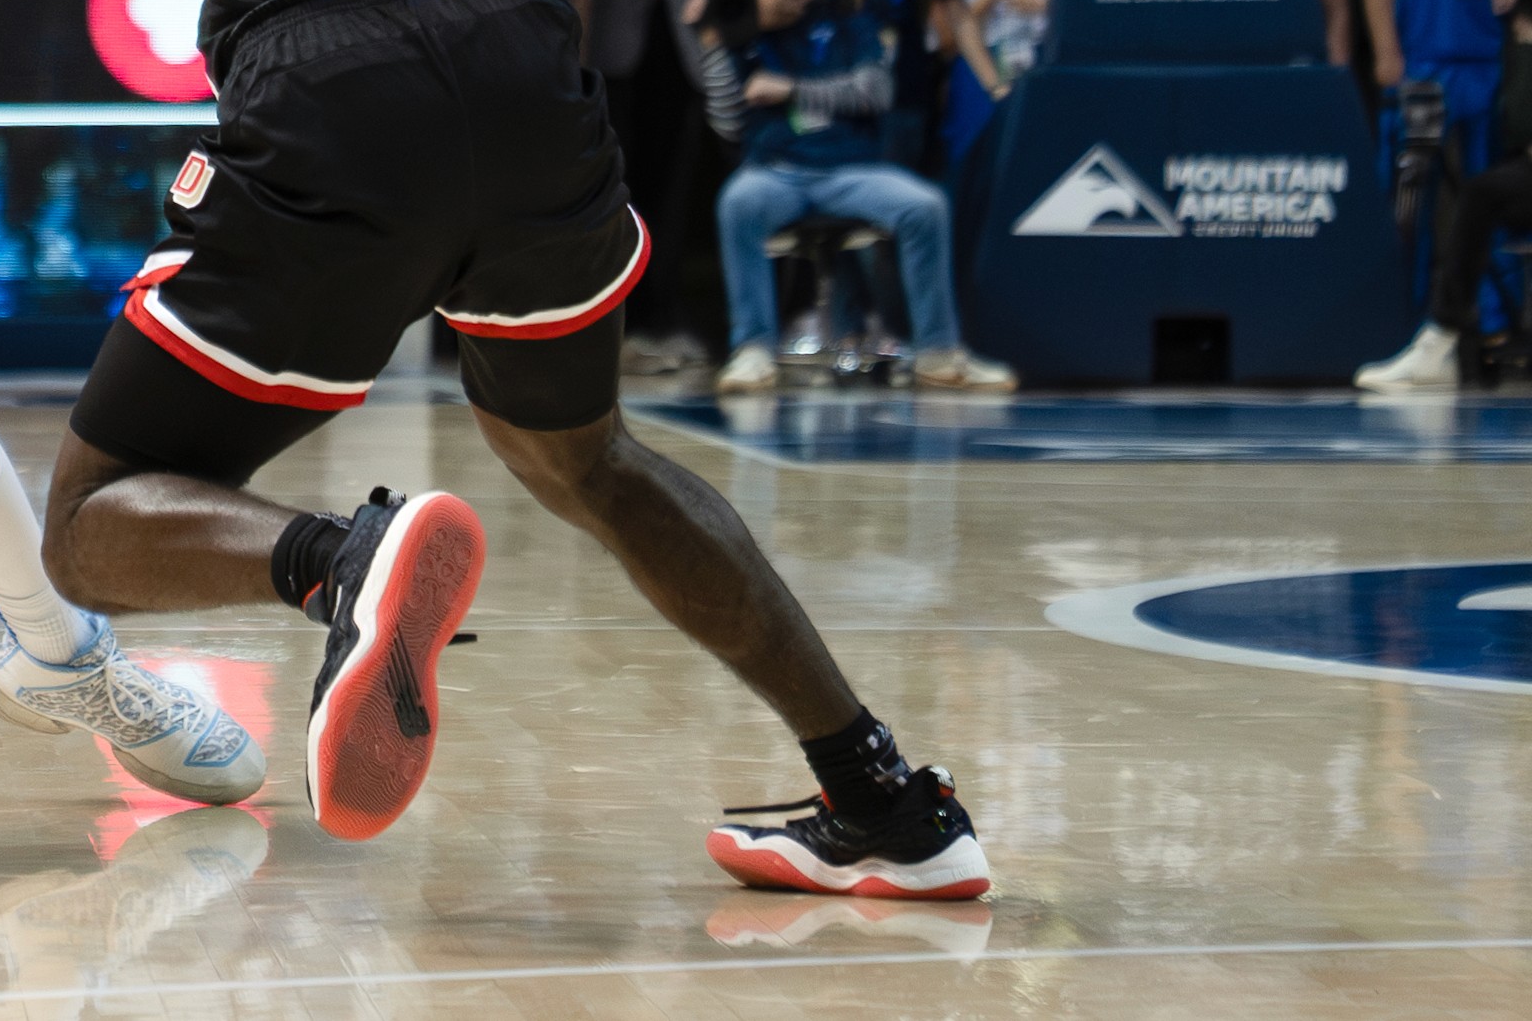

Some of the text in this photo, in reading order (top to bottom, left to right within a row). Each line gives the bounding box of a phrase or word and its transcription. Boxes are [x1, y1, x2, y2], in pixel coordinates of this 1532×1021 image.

[169, 150, 215, 209] D
[1165, 157, 1347, 192] MOUNTAIN
[1176, 191, 1336, 222] AMERICA
